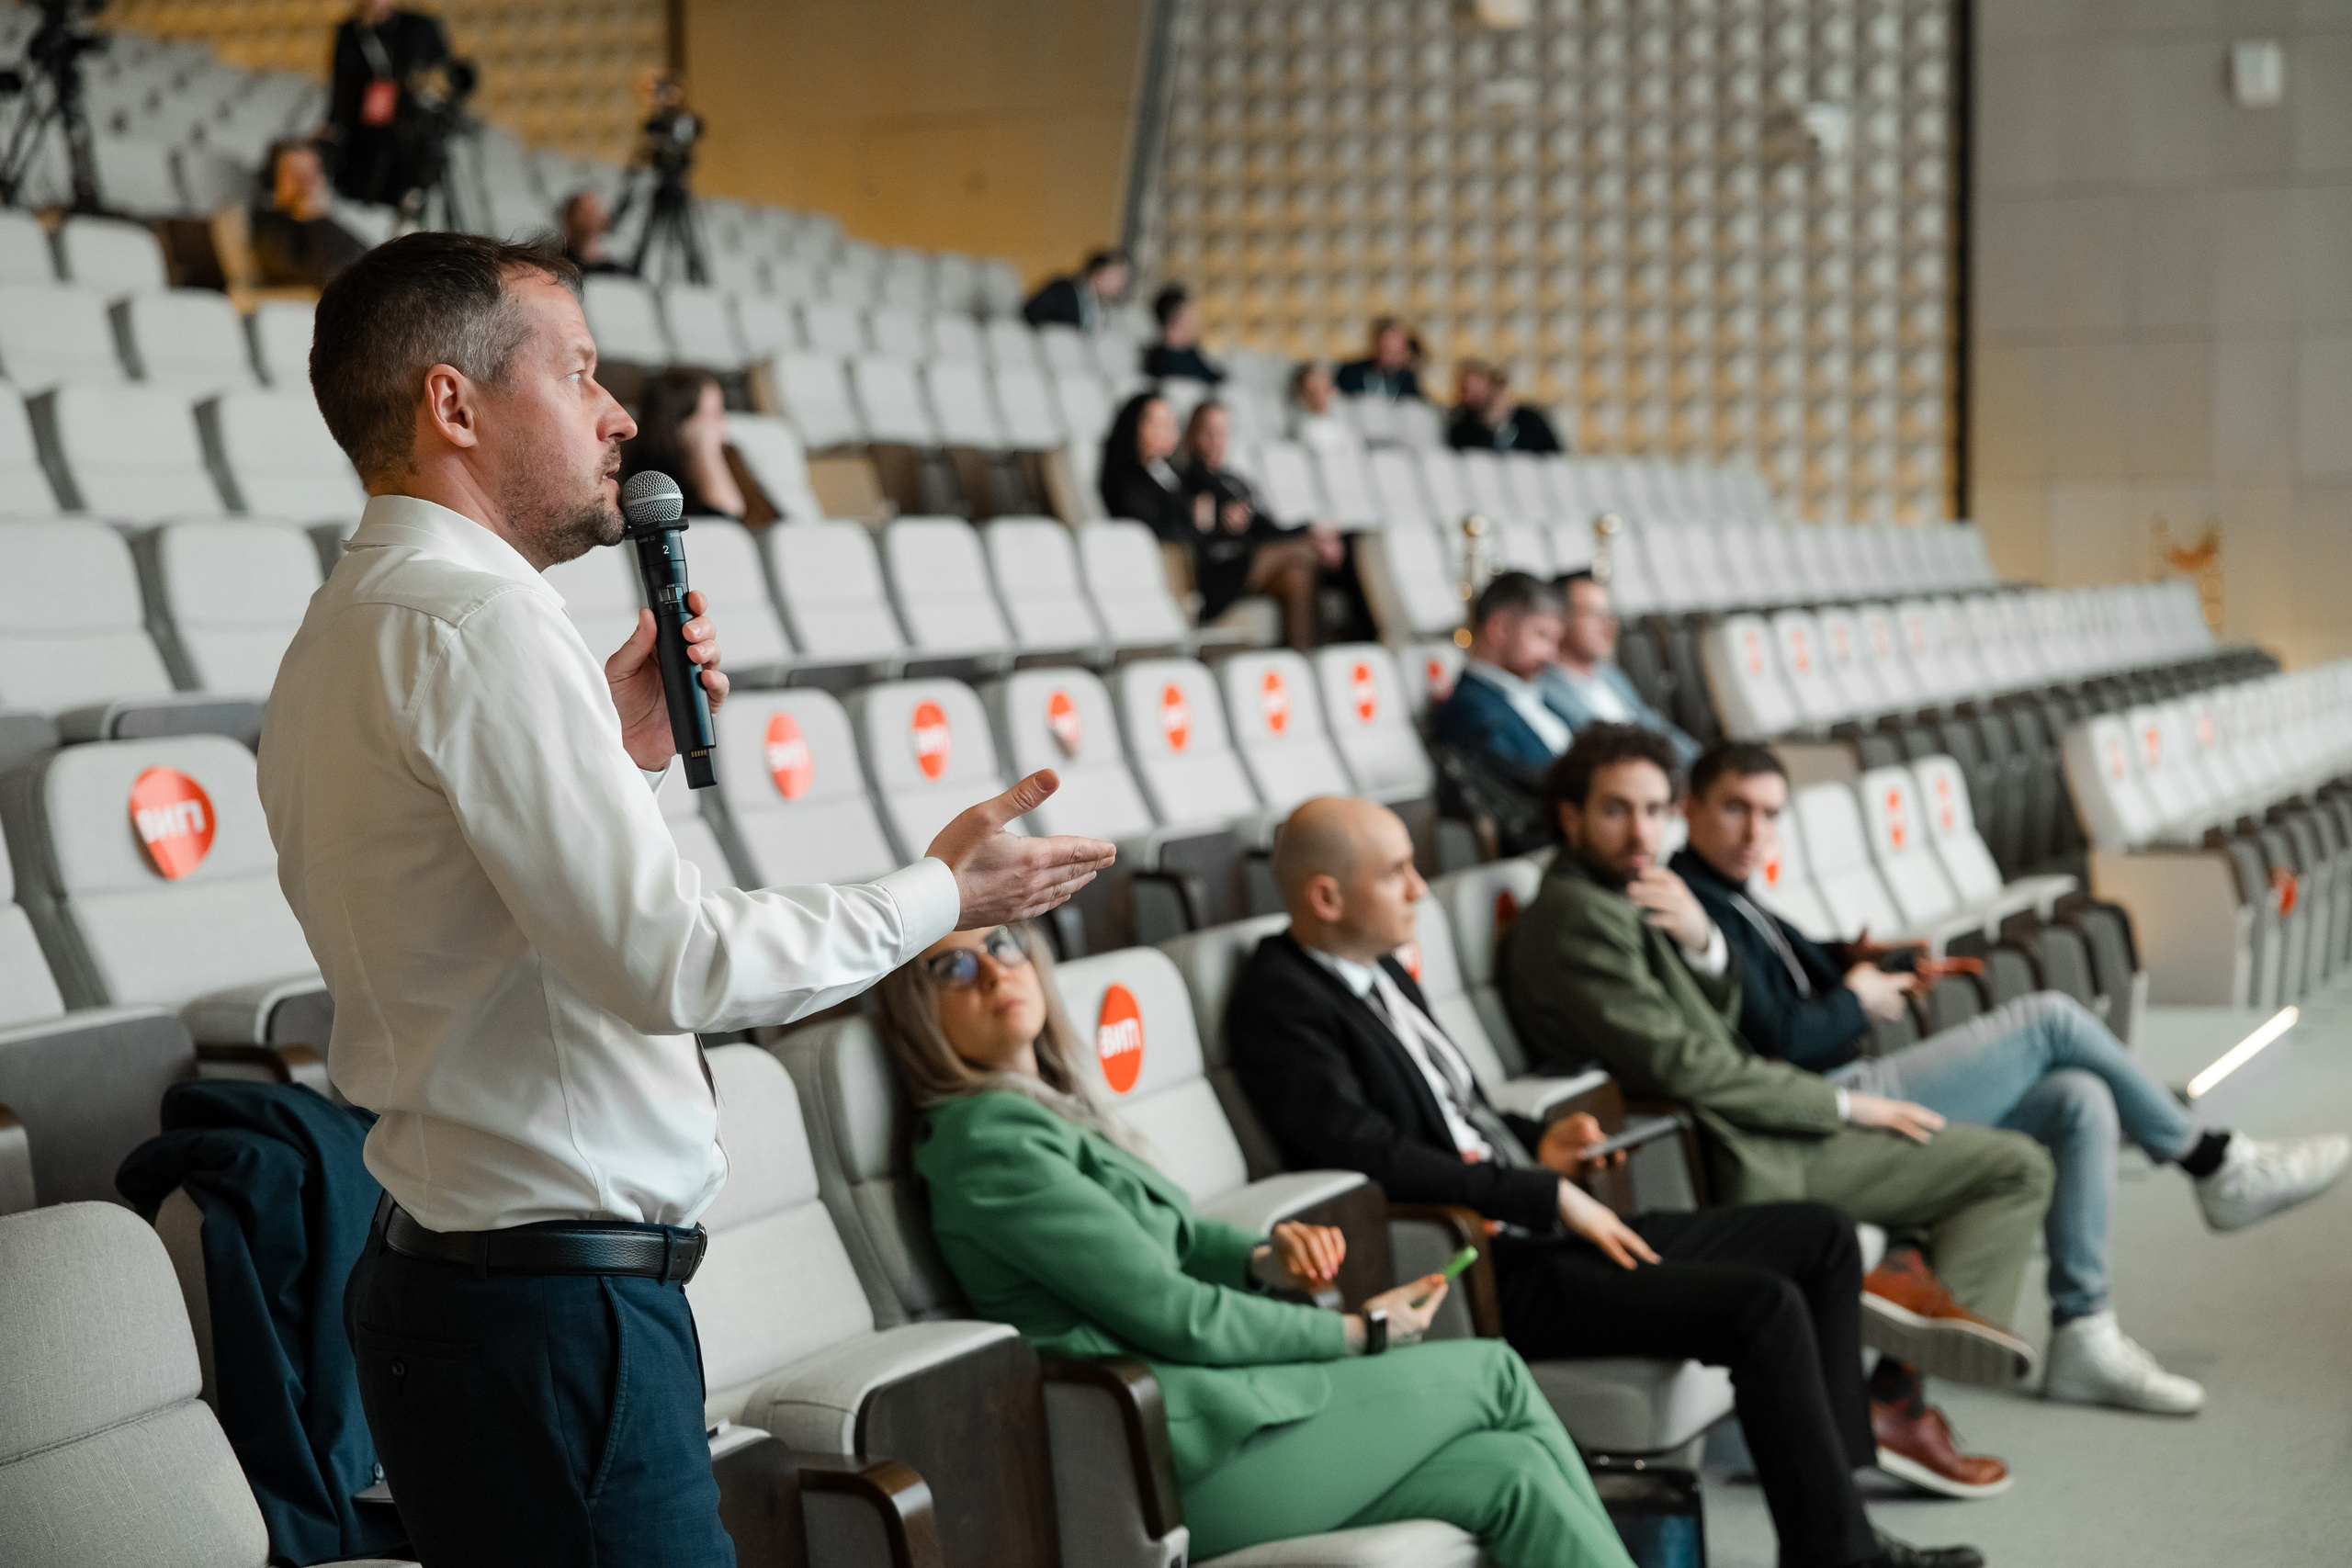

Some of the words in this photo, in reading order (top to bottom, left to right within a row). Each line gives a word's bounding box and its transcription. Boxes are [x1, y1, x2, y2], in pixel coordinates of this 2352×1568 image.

[662, 545, 670, 555] 2
[137, 798, 206, 843] ВИП
[1098, 1017, 1141, 1058] ВИП
